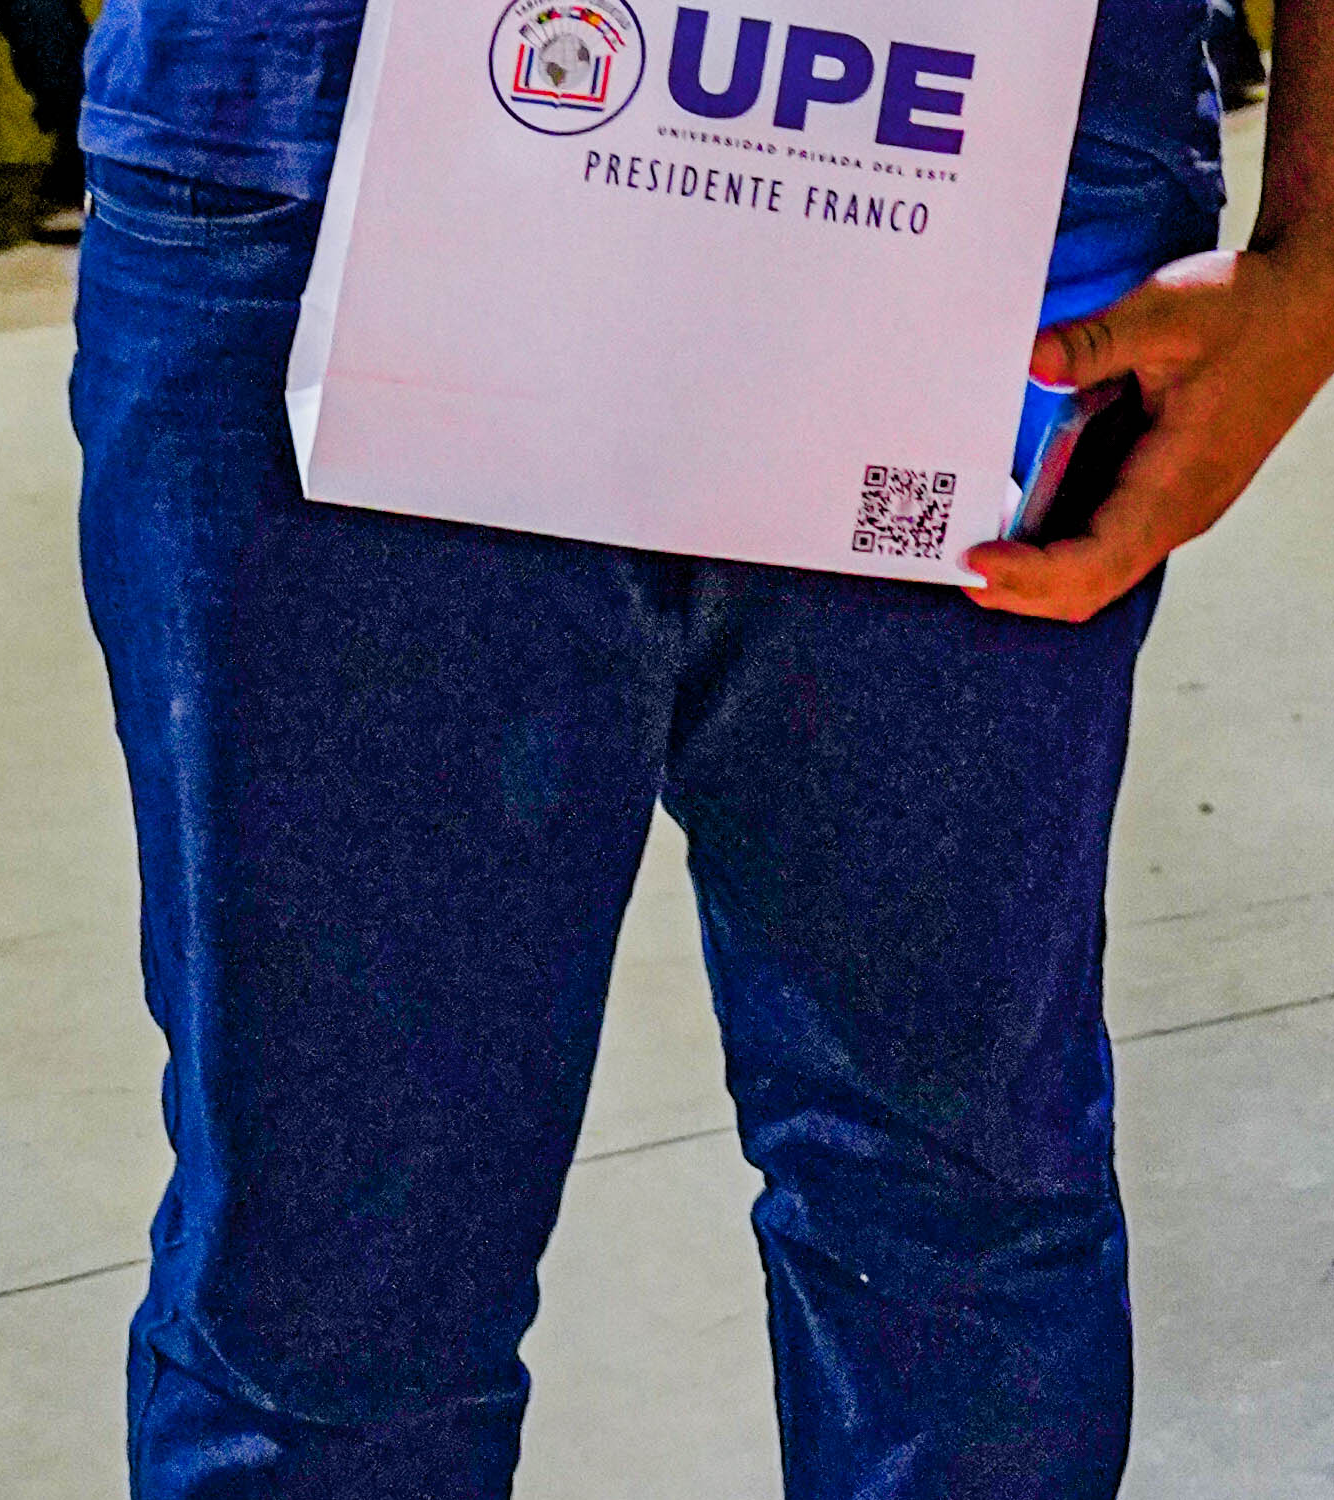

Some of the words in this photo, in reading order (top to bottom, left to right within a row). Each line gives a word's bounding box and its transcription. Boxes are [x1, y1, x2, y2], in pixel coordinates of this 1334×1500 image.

[668, 6, 975, 155] UPE
[584, 150, 784, 212] PRESIDENTE
[804, 186, 929, 235] FRANCO
[657, 126, 777, 155] UNIVERSIDAD
[787, 146, 863, 169] PRIVADA
[873, 161, 905, 177] DEL
[916, 167, 959, 183] ESTE
